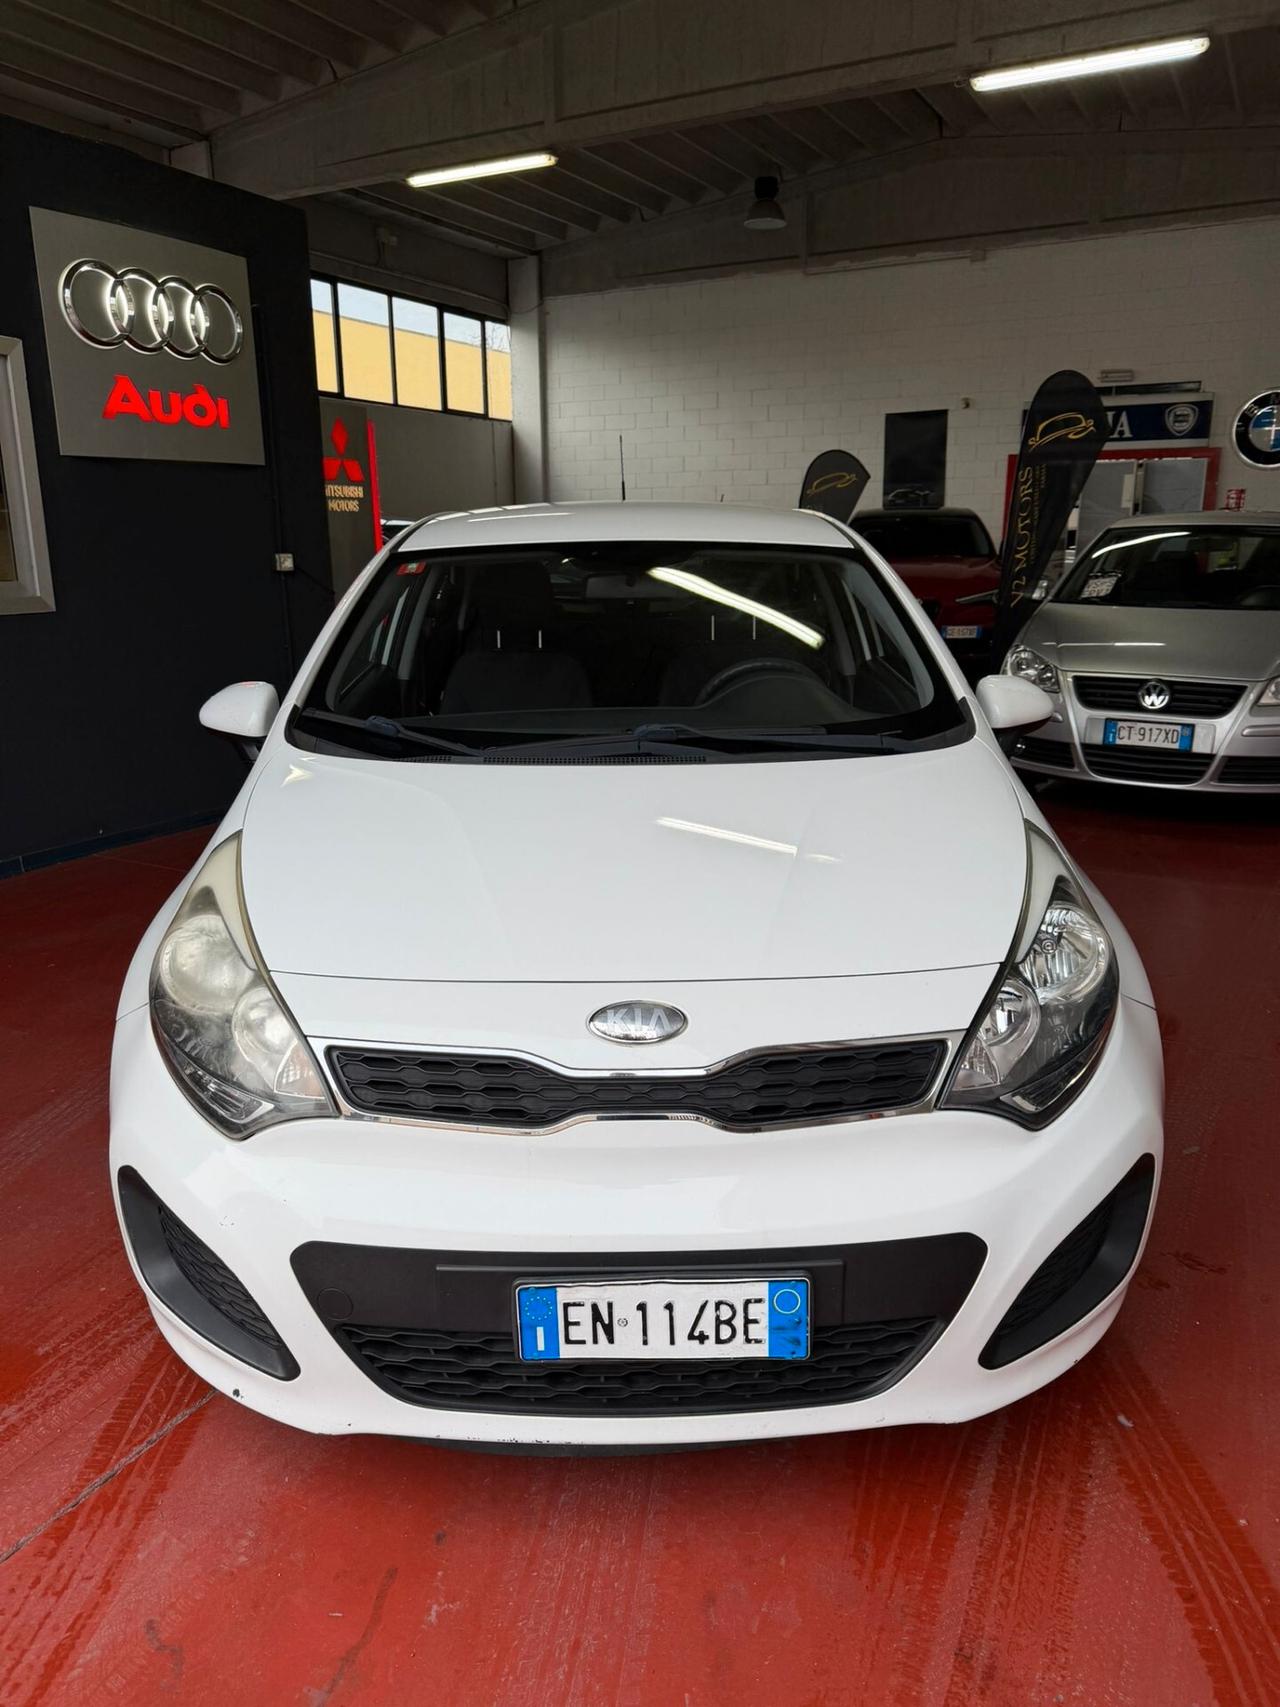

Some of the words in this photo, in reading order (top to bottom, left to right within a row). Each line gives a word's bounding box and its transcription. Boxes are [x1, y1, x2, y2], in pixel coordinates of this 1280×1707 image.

[328, 499, 360, 512] MOTORS
[1014, 466, 1033, 573] MOTORS
[606, 1007, 673, 1034] KIA
